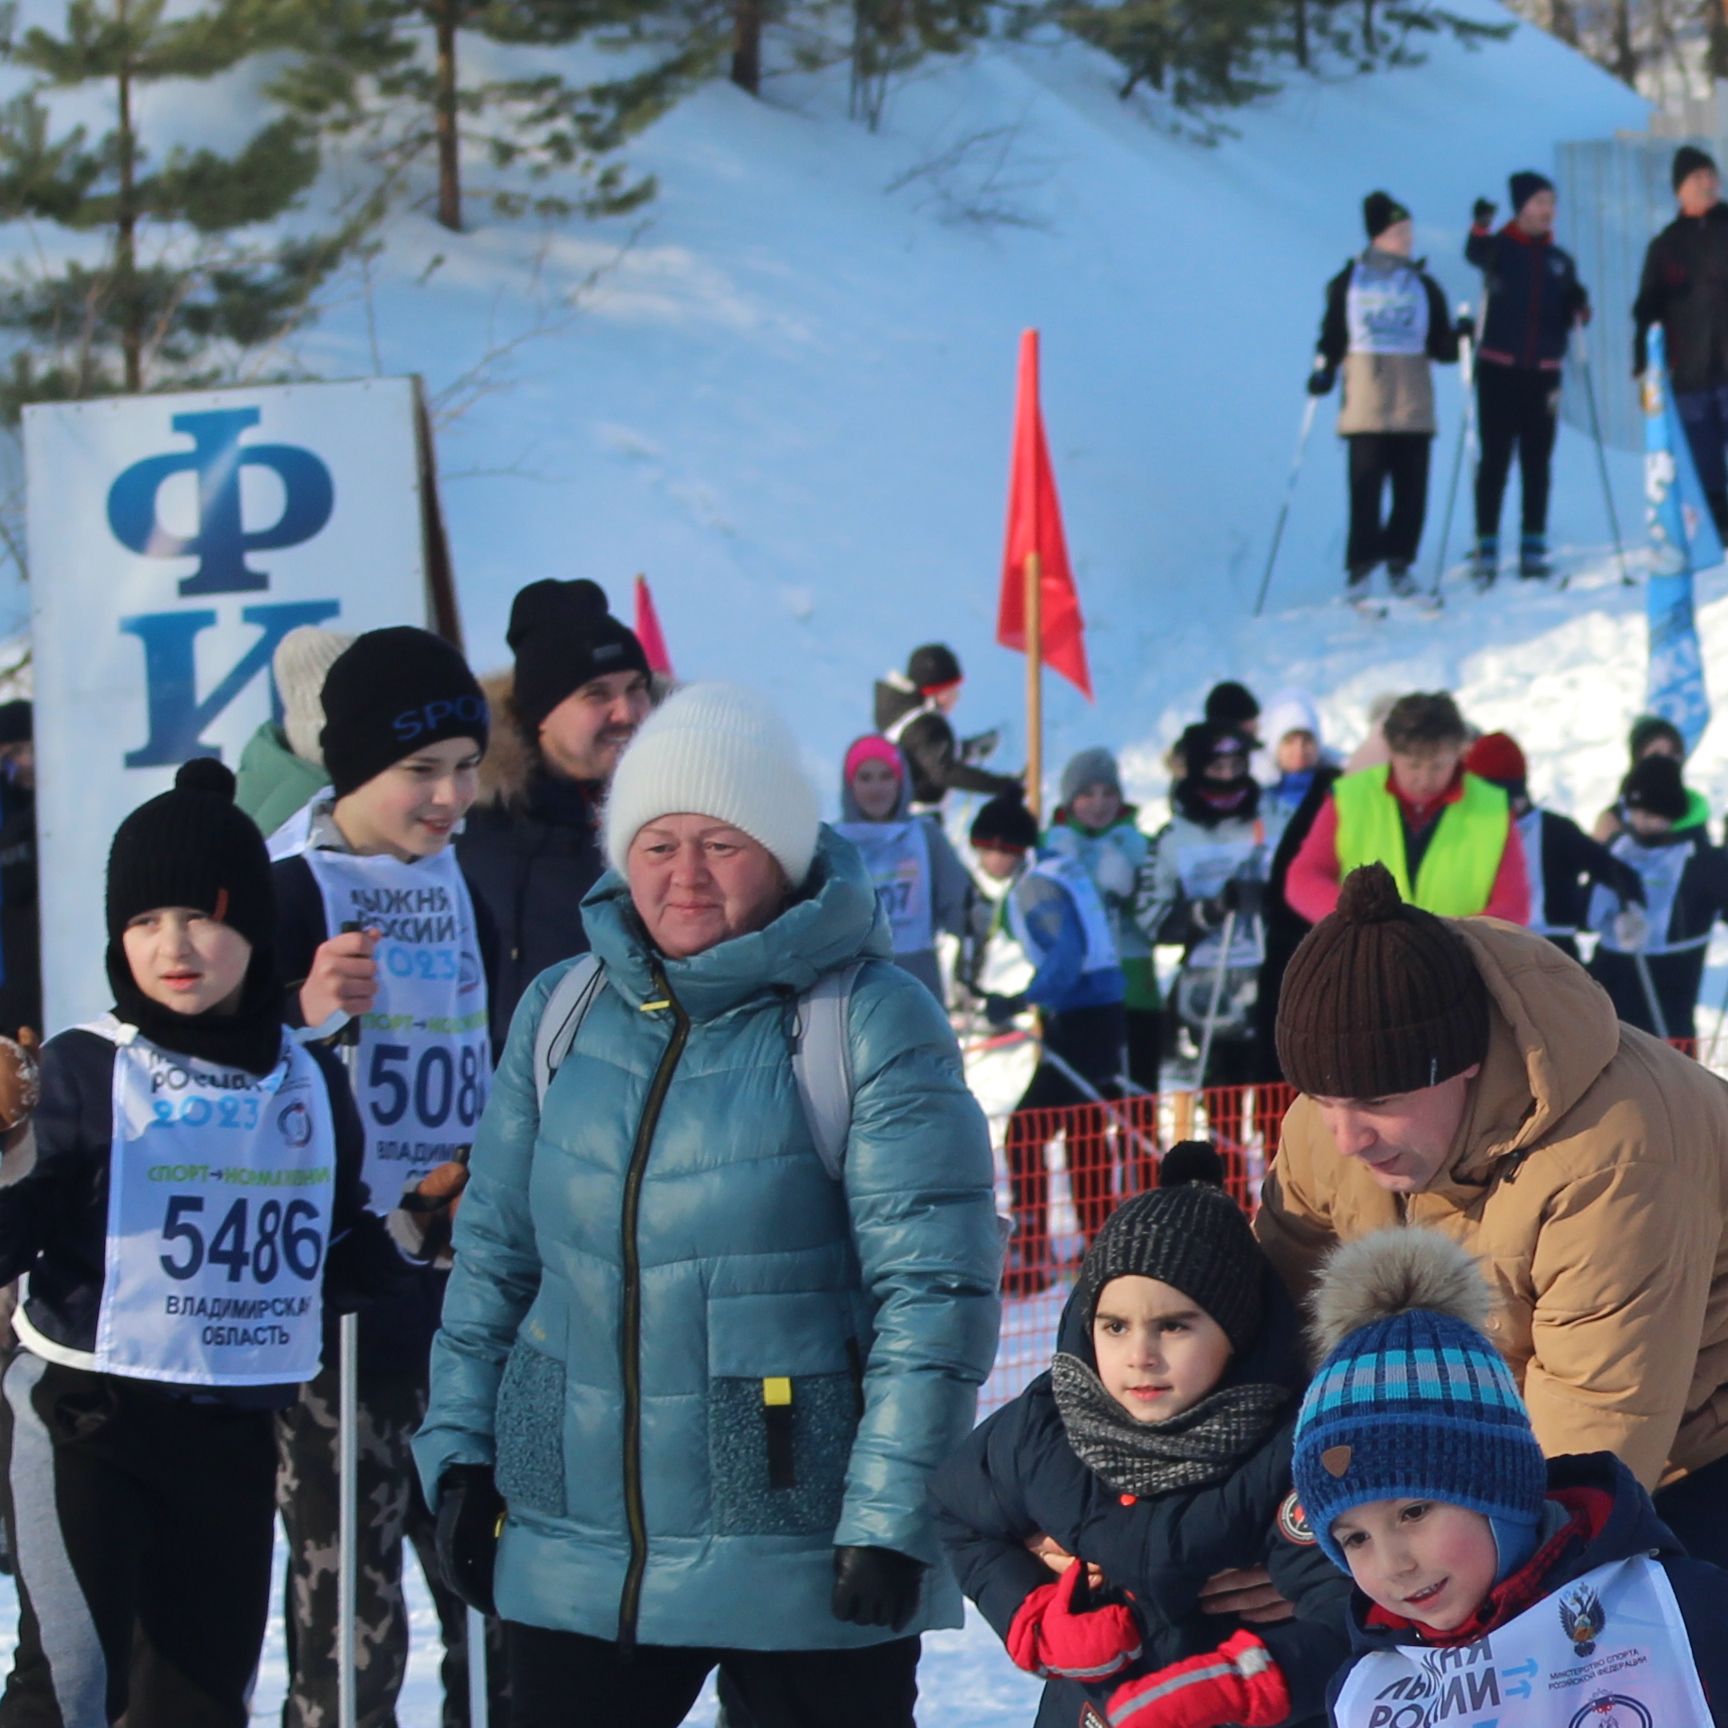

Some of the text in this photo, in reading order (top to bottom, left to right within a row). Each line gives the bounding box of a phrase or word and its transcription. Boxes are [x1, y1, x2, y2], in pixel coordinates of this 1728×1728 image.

[375, 947, 458, 979] 023
[369, 1043, 486, 1128] 508
[152, 1095, 260, 1130] 2023
[160, 1195, 322, 1285] 5486
[202, 1325, 290, 1346] ОБЛАСТЬ
[1597, 1655, 1648, 1677] ФЕДЕРАЦИИ
[1606, 1648, 1640, 1665] СПОРТА
